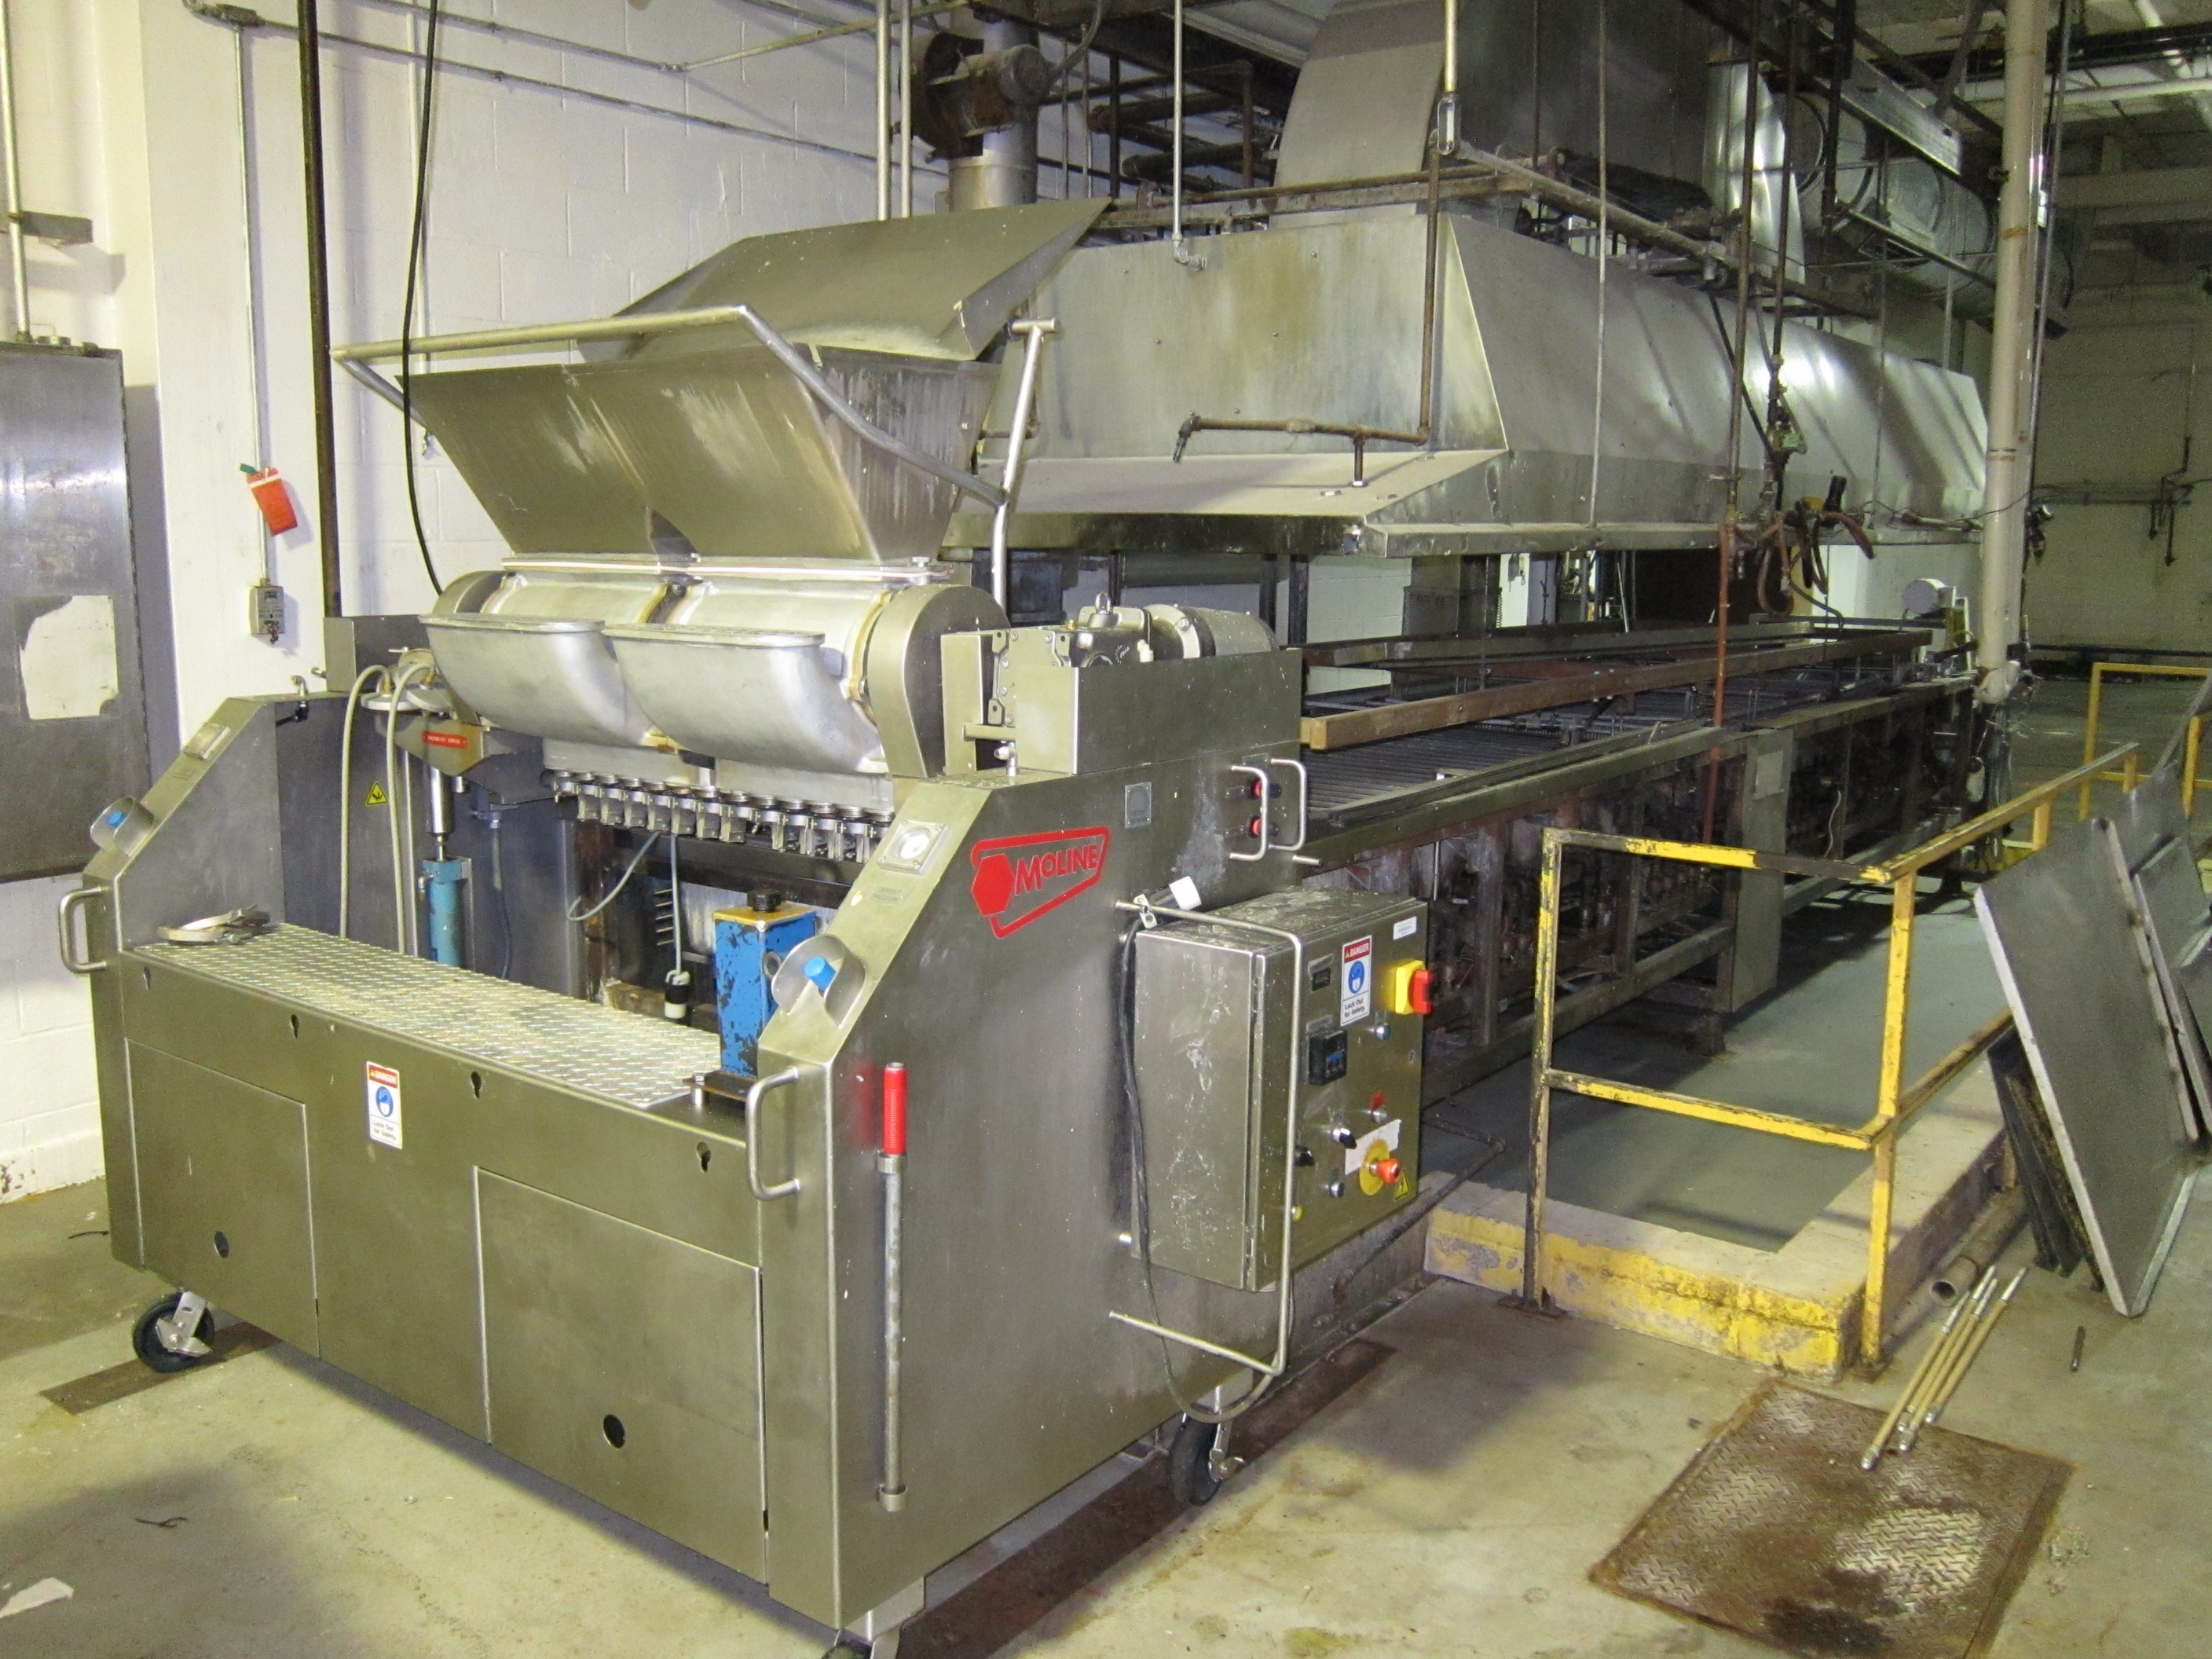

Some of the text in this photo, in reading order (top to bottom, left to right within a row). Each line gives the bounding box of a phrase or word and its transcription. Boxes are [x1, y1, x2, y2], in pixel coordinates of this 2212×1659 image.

[1015, 844, 1098, 896] MOLINE
[1350, 943, 1369, 958] DANGER
[1344, 1001, 1355, 1010] Lock
